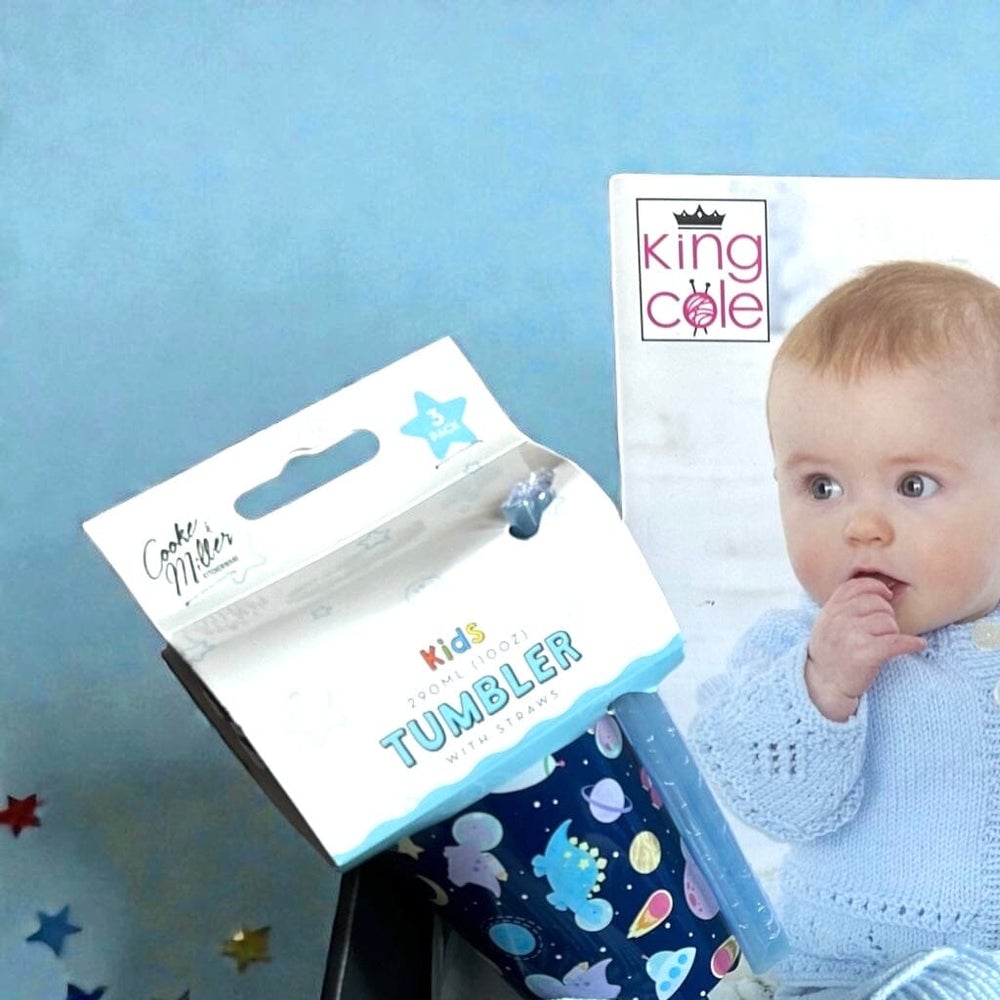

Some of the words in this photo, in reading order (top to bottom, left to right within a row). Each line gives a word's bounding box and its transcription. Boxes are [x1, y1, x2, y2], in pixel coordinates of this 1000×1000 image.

[643, 233, 763, 284] king
[646, 280, 764, 329] cole
[425, 407, 446, 428] 3
[143, 519, 198, 580] Cooke
[165, 531, 233, 597] Miller
[419, 622, 486, 671] Kids
[379, 630, 583, 769] TUMBLER
[445, 733, 489, 764] WITH
[496, 689, 560, 735] STRAWS
